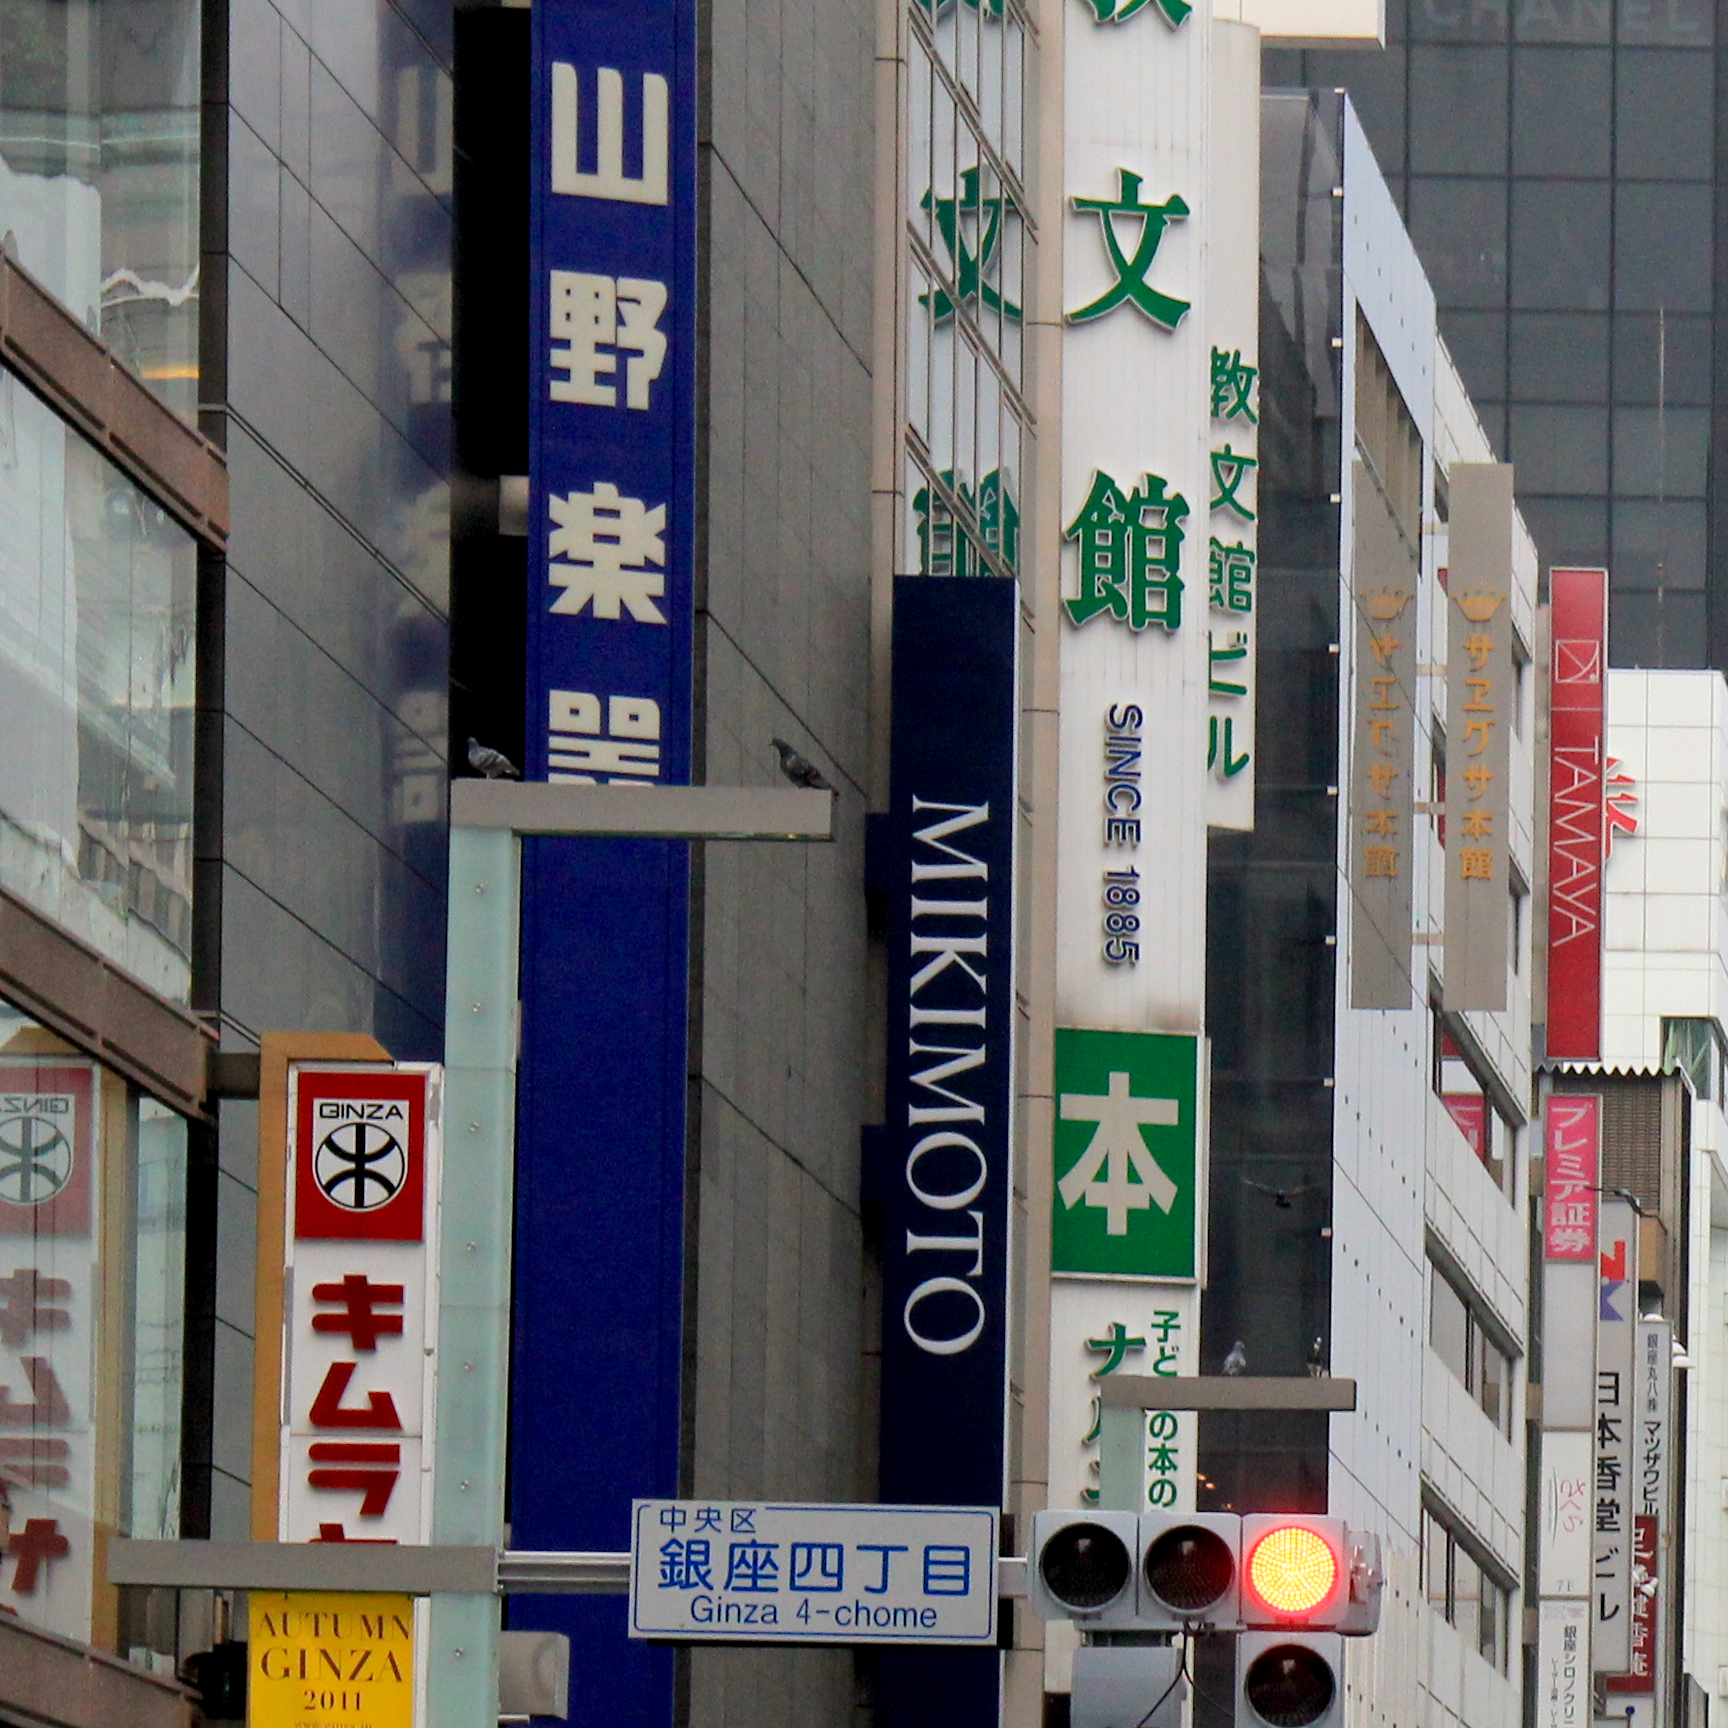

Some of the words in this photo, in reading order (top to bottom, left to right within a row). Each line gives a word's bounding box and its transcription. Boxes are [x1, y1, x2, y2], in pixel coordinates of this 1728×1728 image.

[1066, 0, 1192, 633] 文館
[1105, 702, 1143, 846] SINCE
[1552, 736, 1599, 948] TAMAYA
[1101, 867, 1141, 966] 1885
[318, 1101, 405, 1122] GINZA
[904, 794, 990, 1356] MIKIMOTO
[1057, 1071, 1180, 1236] 本
[1550, 1104, 1595, 1254] プレミア証券
[309, 1273, 406, 1544] キムラ
[658, 1539, 971, 1596] 銀座四丁目
[659, 1507, 757, 1535] 中央区
[255, 1611, 412, 1643] AUTUMN
[690, 1595, 779, 1629] Ginza
[796, 1599, 937, 1631] 4-chome
[260, 1648, 405, 1684] GINZA
[303, 1691, 364, 1713] 2011
